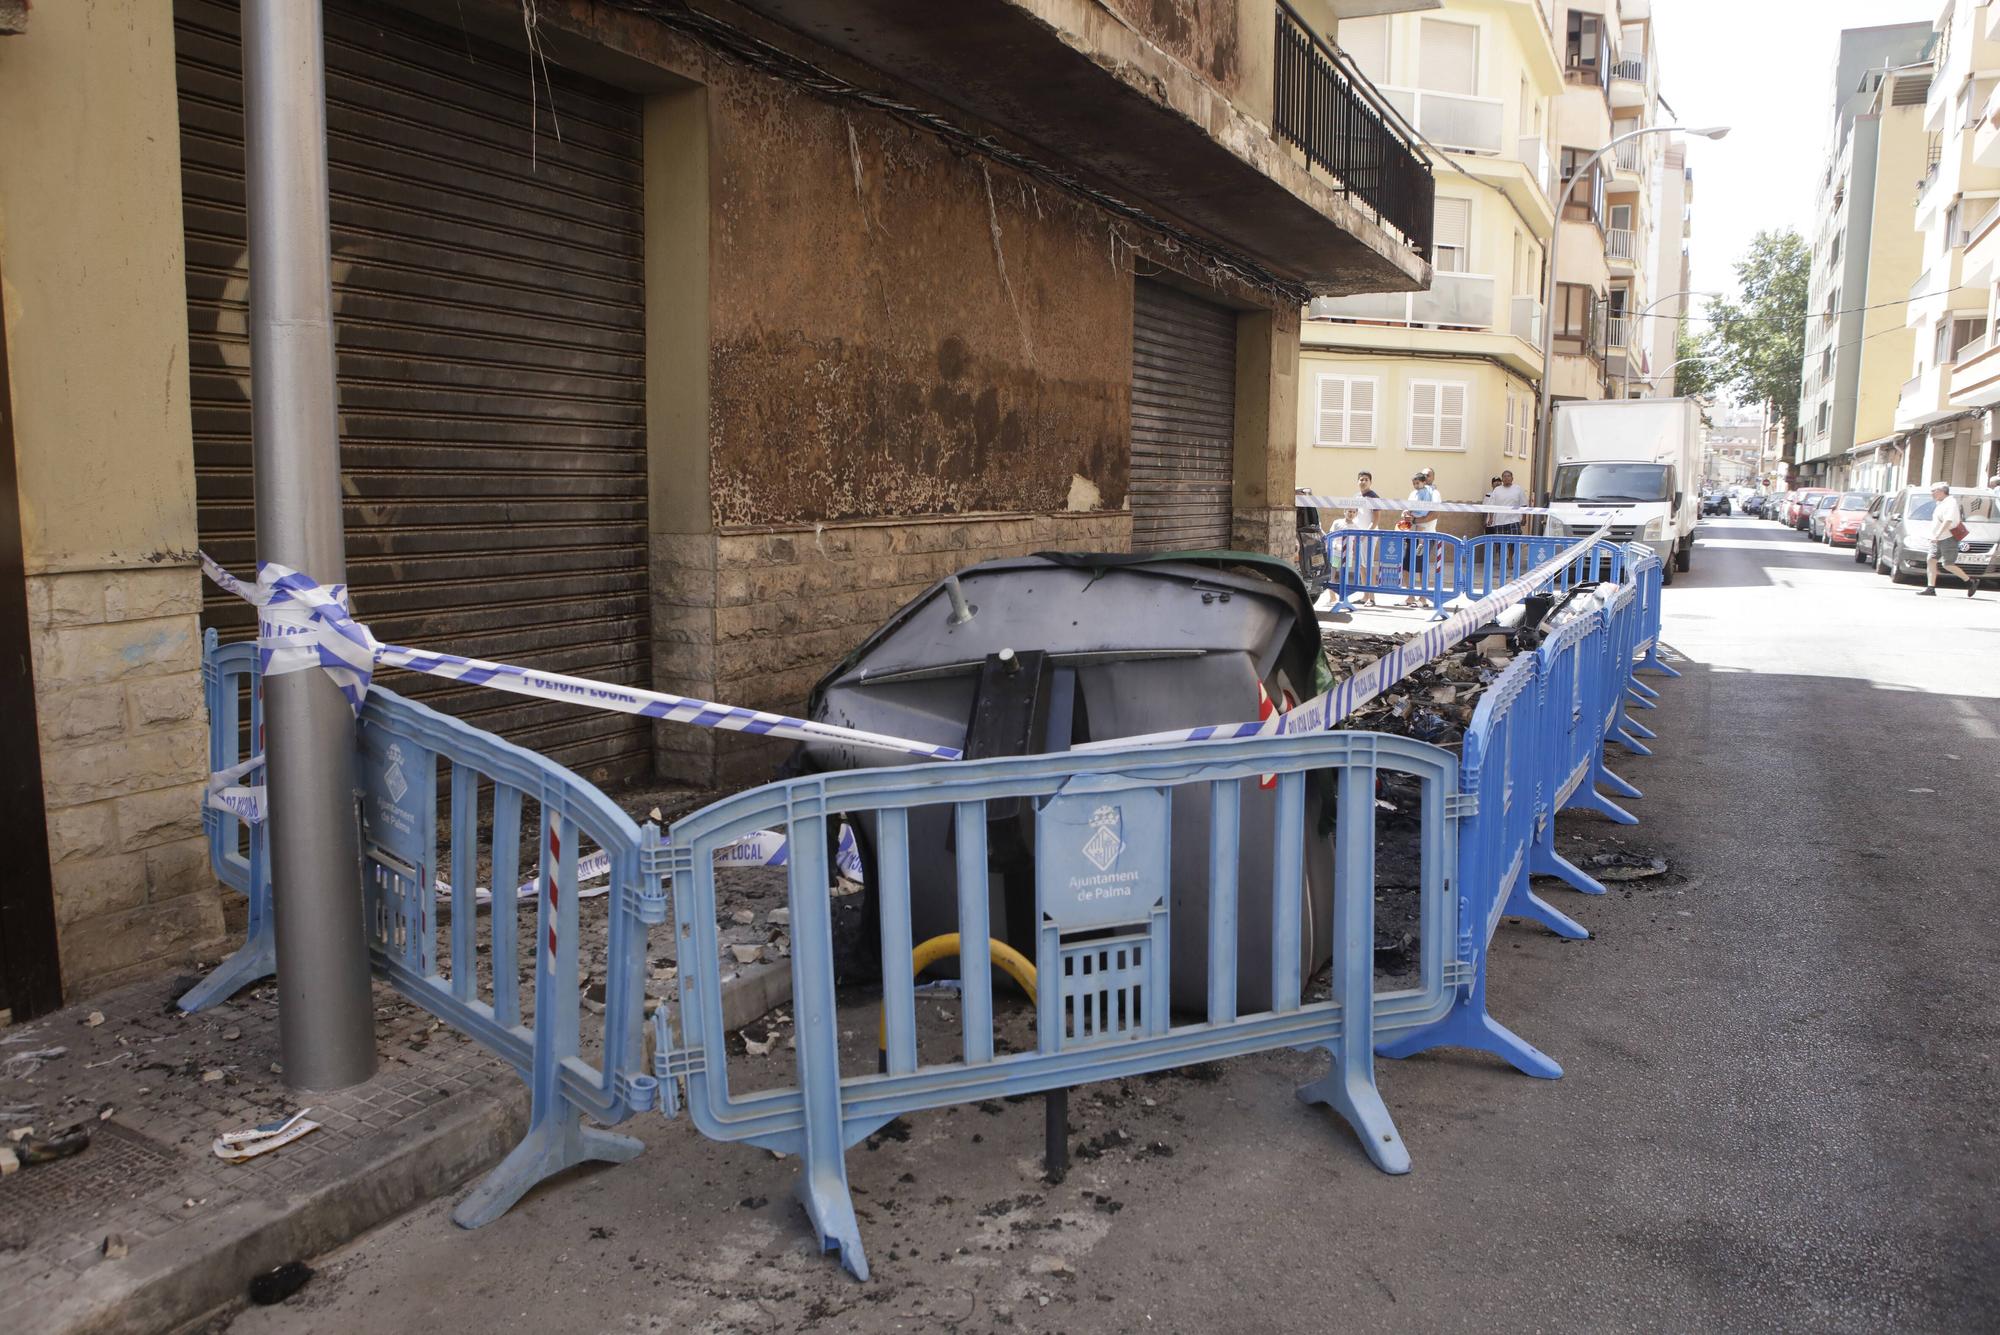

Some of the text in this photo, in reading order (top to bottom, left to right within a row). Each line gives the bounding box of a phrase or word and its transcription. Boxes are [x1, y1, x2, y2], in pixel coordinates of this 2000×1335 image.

[732, 843, 764, 861] LOCAL
[1069, 870, 1139, 889] Ajuntament
[1077, 885, 1131, 902] de Palma
